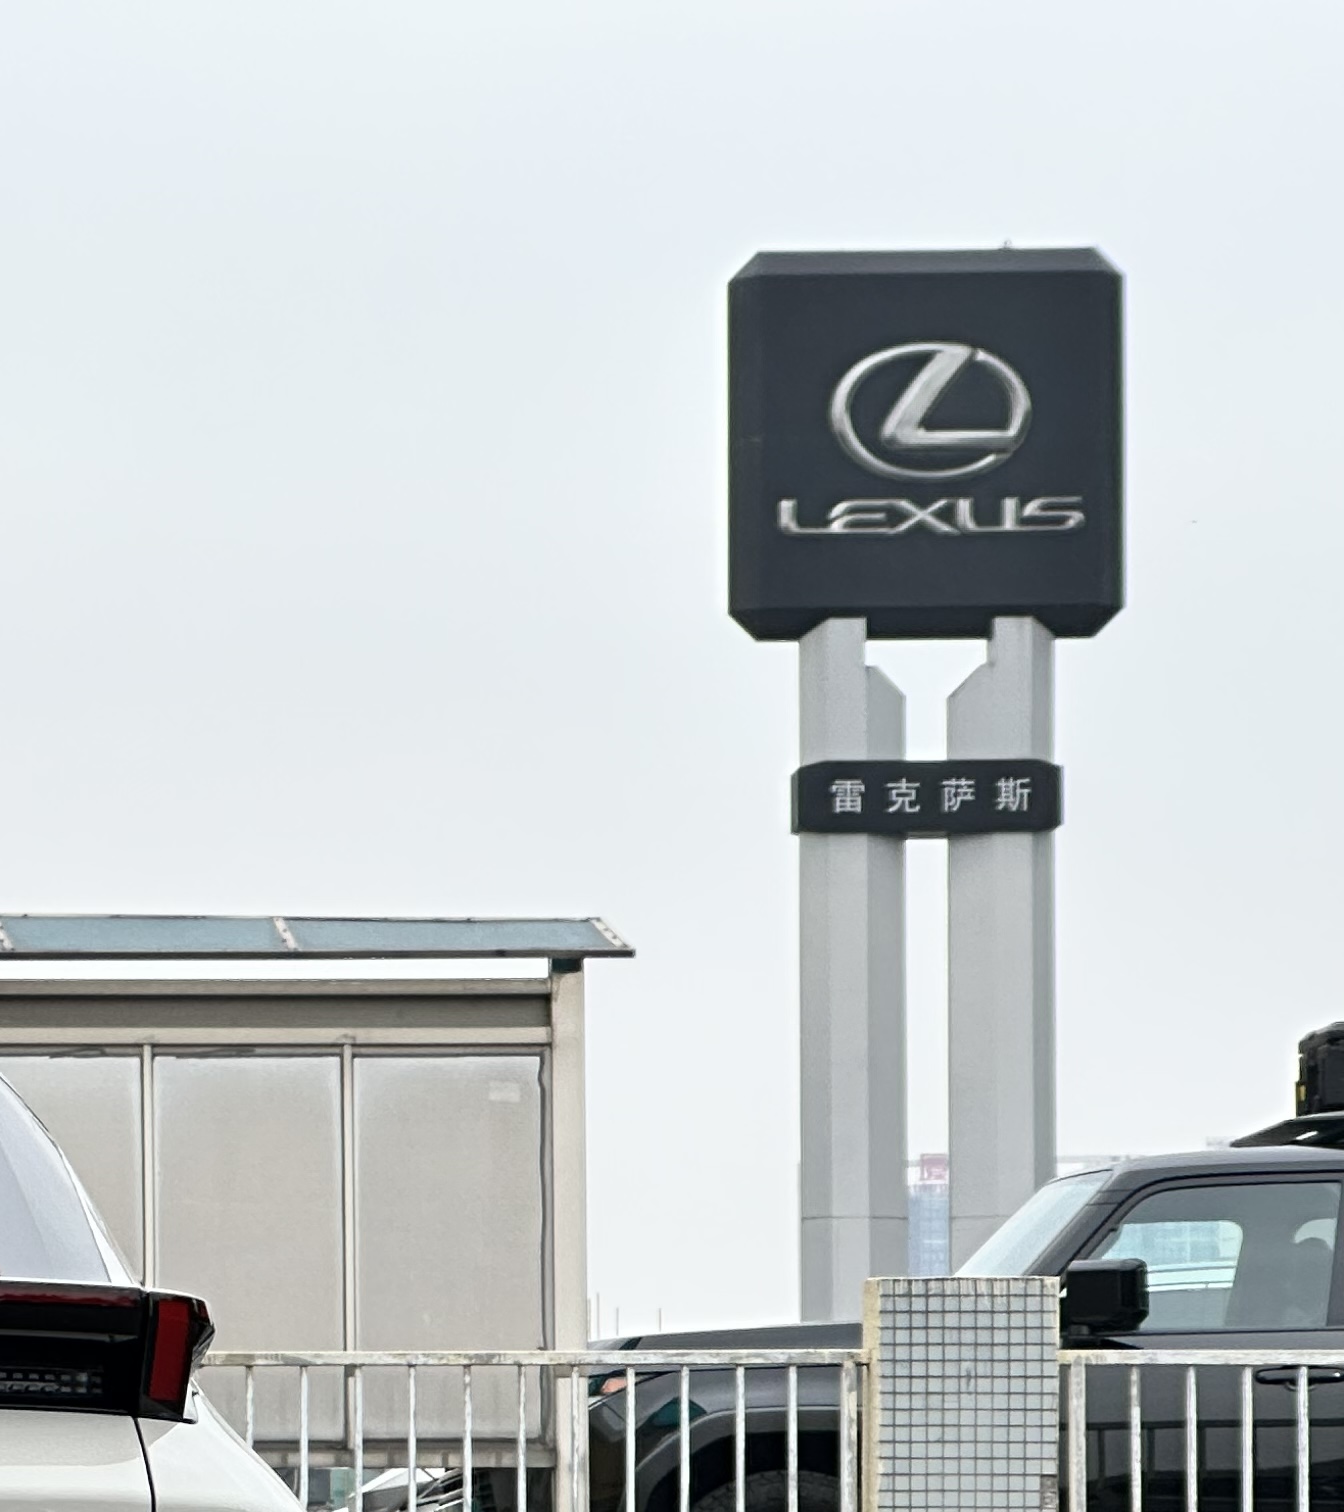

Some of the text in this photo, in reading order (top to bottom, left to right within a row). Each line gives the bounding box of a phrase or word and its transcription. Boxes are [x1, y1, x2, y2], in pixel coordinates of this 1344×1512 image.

[776, 495, 1086, 535] LEXUS
[829, 777, 1032, 814] 雷克萨斯
